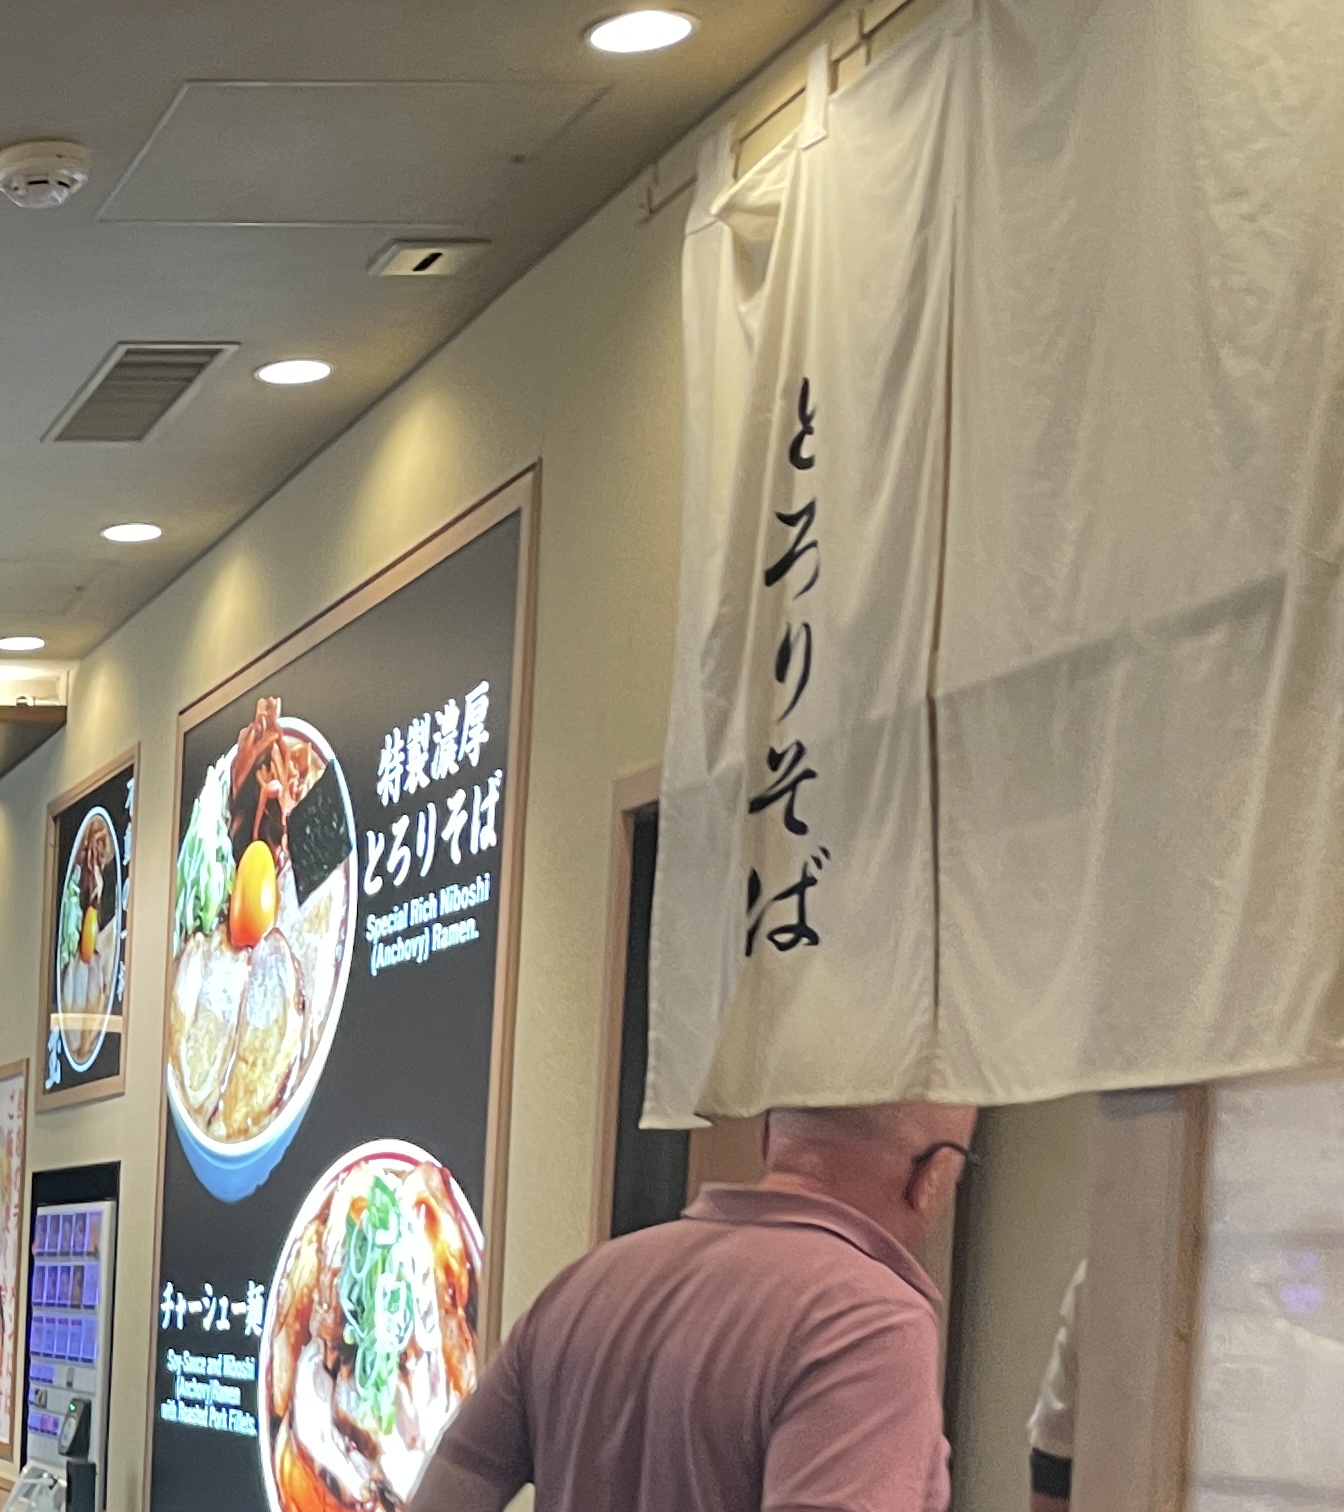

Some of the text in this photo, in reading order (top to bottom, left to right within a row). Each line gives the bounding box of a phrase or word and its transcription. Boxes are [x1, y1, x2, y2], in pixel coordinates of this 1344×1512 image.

[745, 377, 831, 958] とろりそば
[376, 680, 490, 807] 特製濃厚
[363, 769, 503, 895] とろりそば
[366, 872, 491, 943] Special Rich Niboshi
[370, 918, 480, 976] (Anchovy) Ramen.
[161, 1280, 265, 1336] チャーシュー麺
